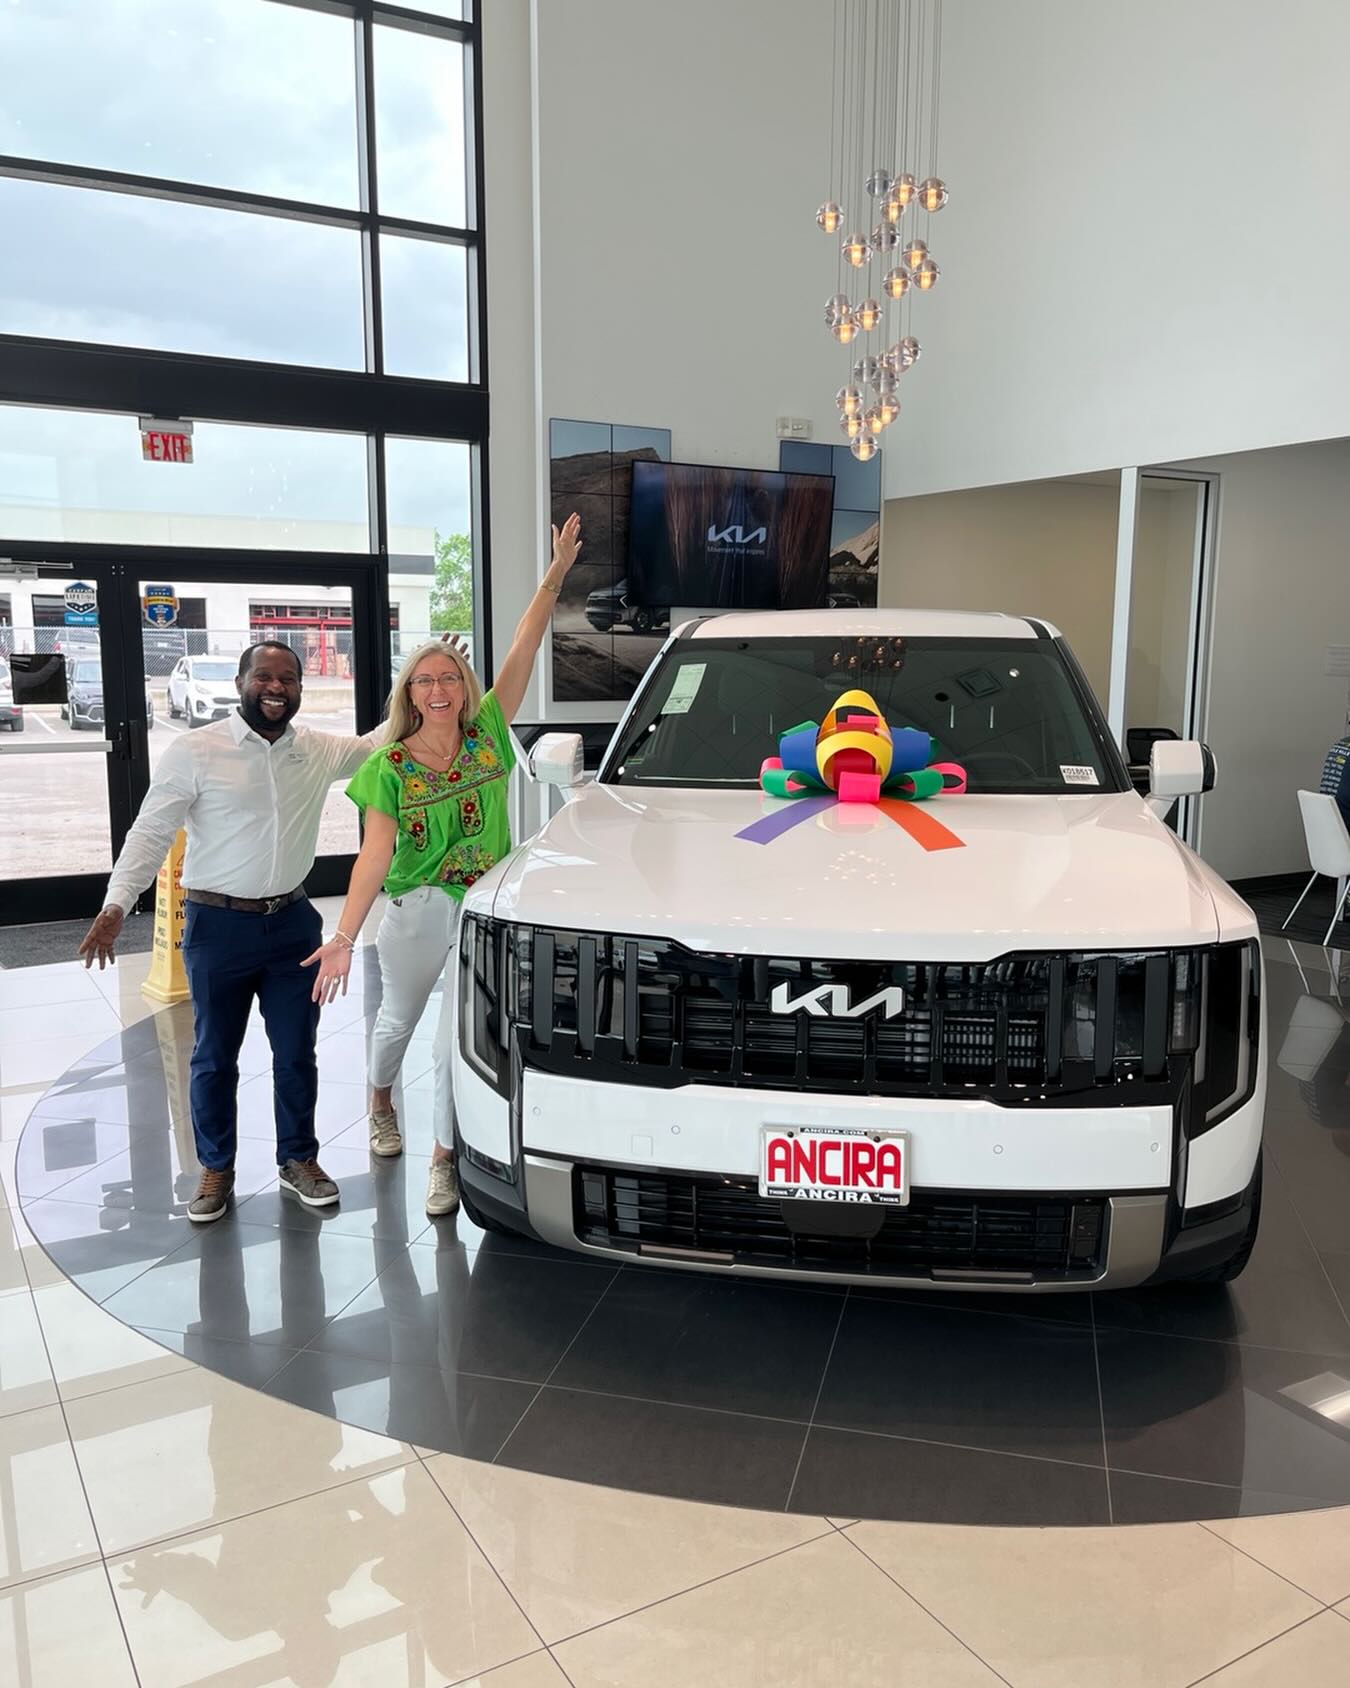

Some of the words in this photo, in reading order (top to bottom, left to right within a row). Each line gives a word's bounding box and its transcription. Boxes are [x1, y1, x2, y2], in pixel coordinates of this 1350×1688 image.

[149, 432, 188, 462] EXIT
[707, 524, 767, 544] KIA
[770, 981, 904, 1018] KIA
[803, 1127, 866, 1136] ANCIRA.COM
[768, 1138, 901, 1189] ANCIRA
[795, 1188, 873, 1203] ANCIRA
